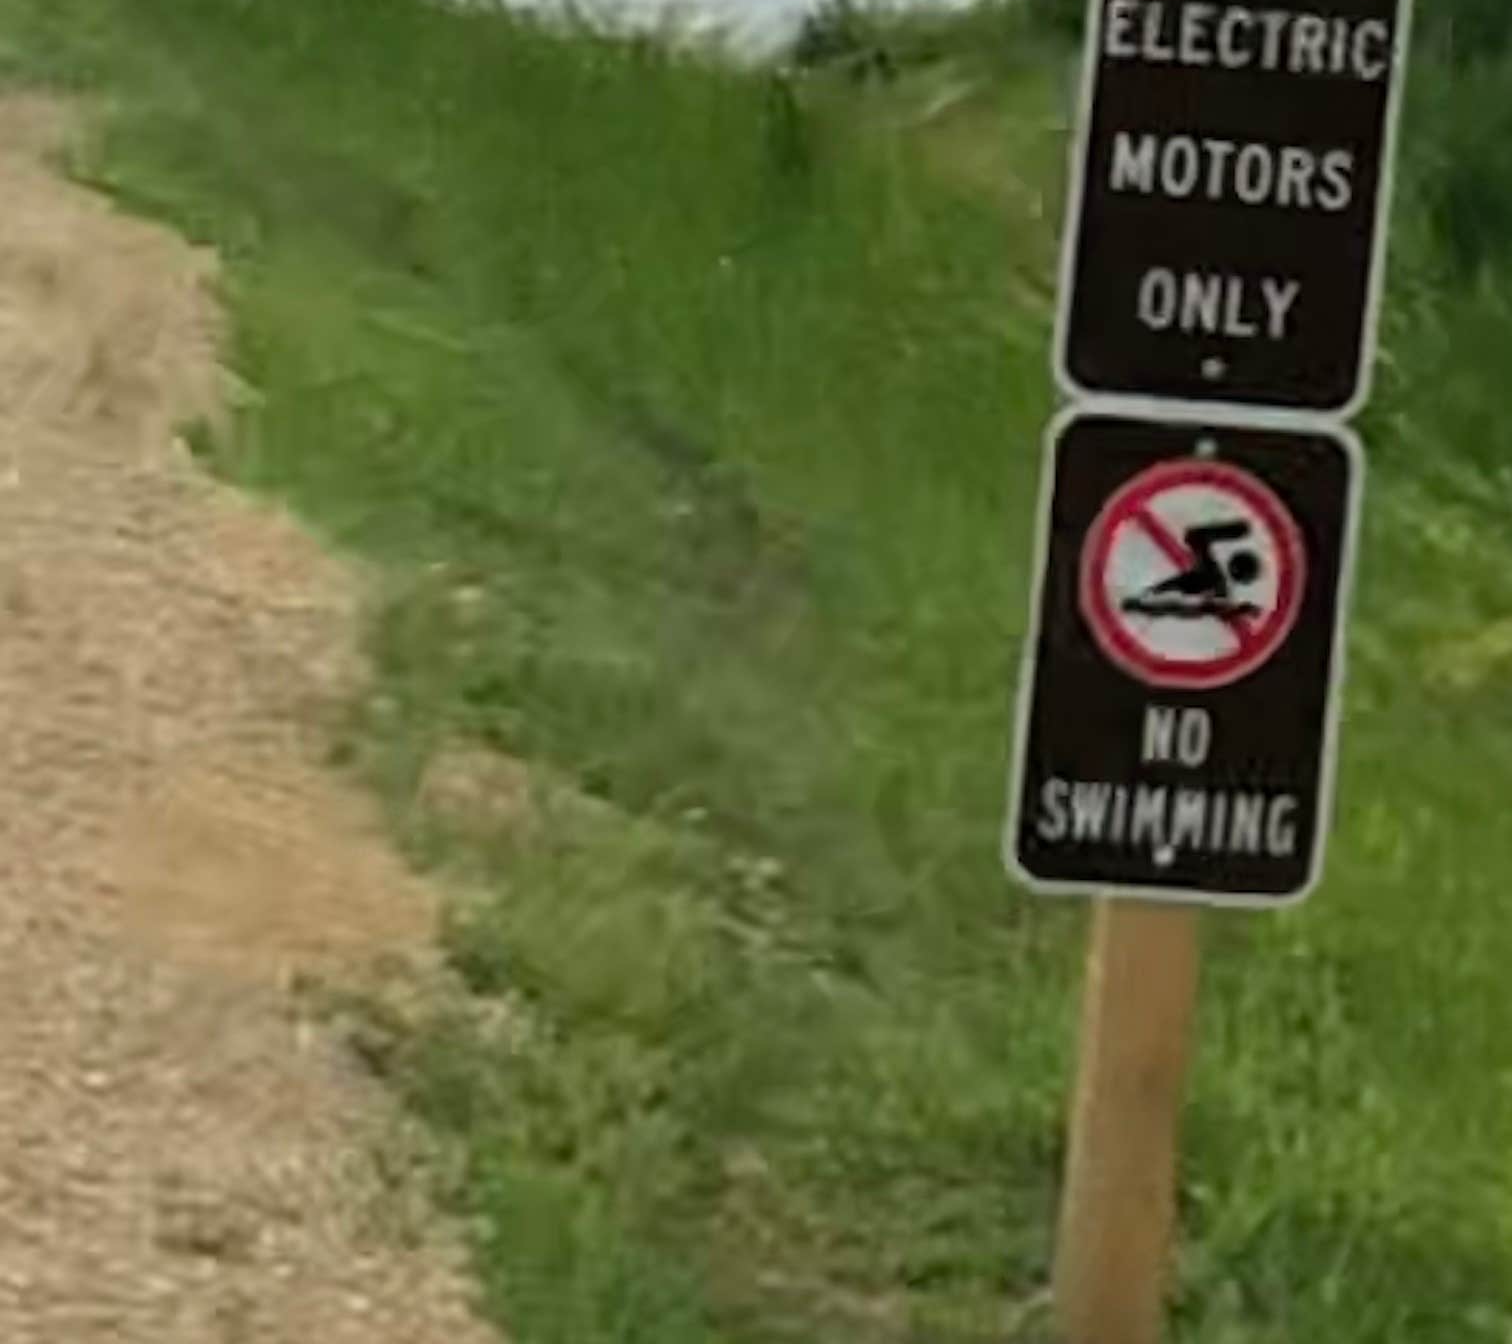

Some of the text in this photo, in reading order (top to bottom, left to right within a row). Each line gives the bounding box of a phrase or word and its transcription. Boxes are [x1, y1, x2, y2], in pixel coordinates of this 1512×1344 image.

[1109, 132, 1354, 209] MOTORS
[1137, 267, 1300, 339] ONLY
[1142, 704, 1213, 767] NO
[1036, 778, 1298, 856] SWIMMING
